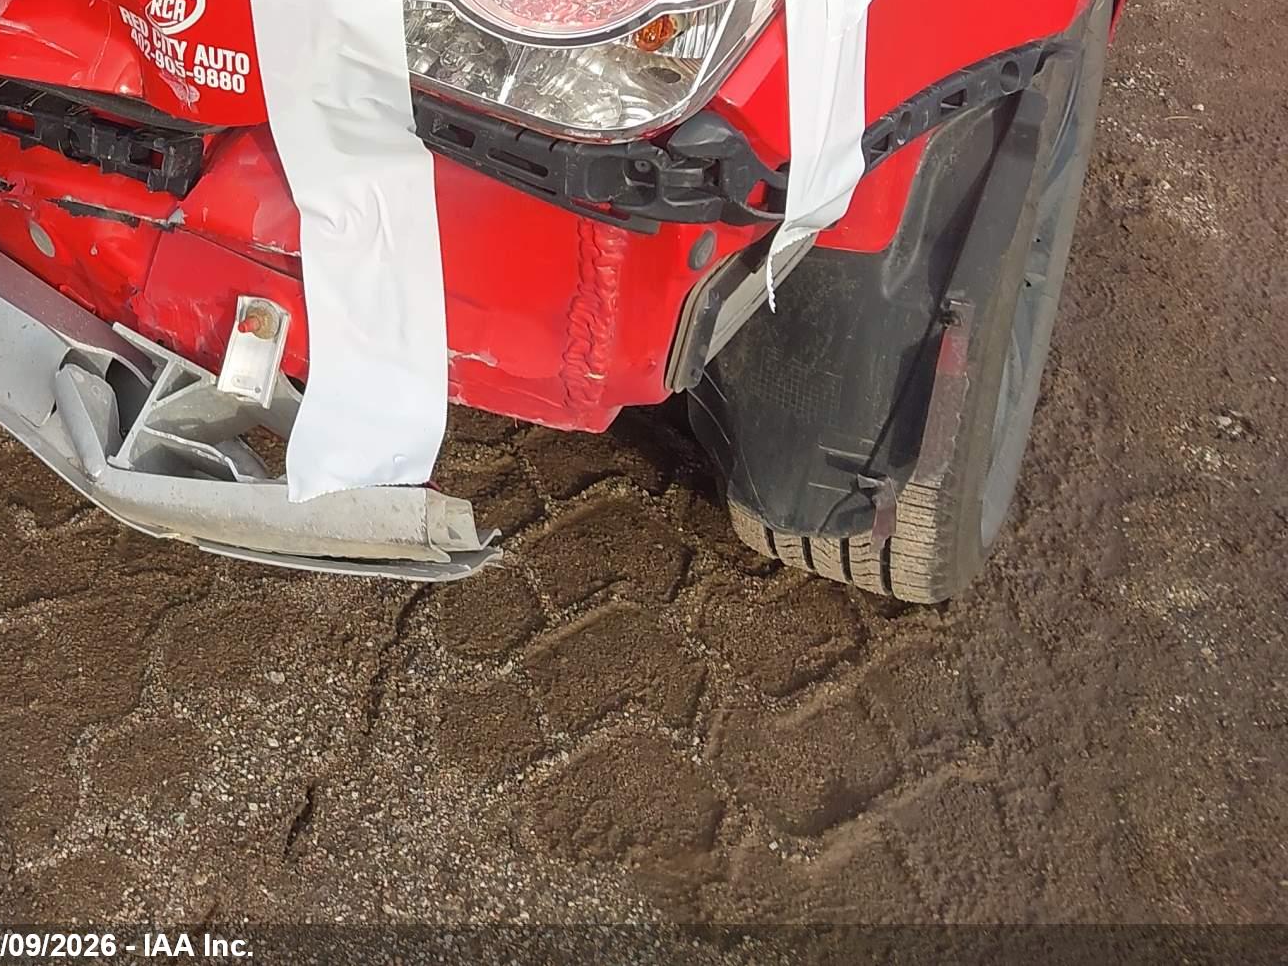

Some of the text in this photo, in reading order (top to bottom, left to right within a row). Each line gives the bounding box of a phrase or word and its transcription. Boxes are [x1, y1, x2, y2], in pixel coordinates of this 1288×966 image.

[119, 5, 250, 75] RED CITY AUTO
[130, 28, 246, 94] 402-905-9880
